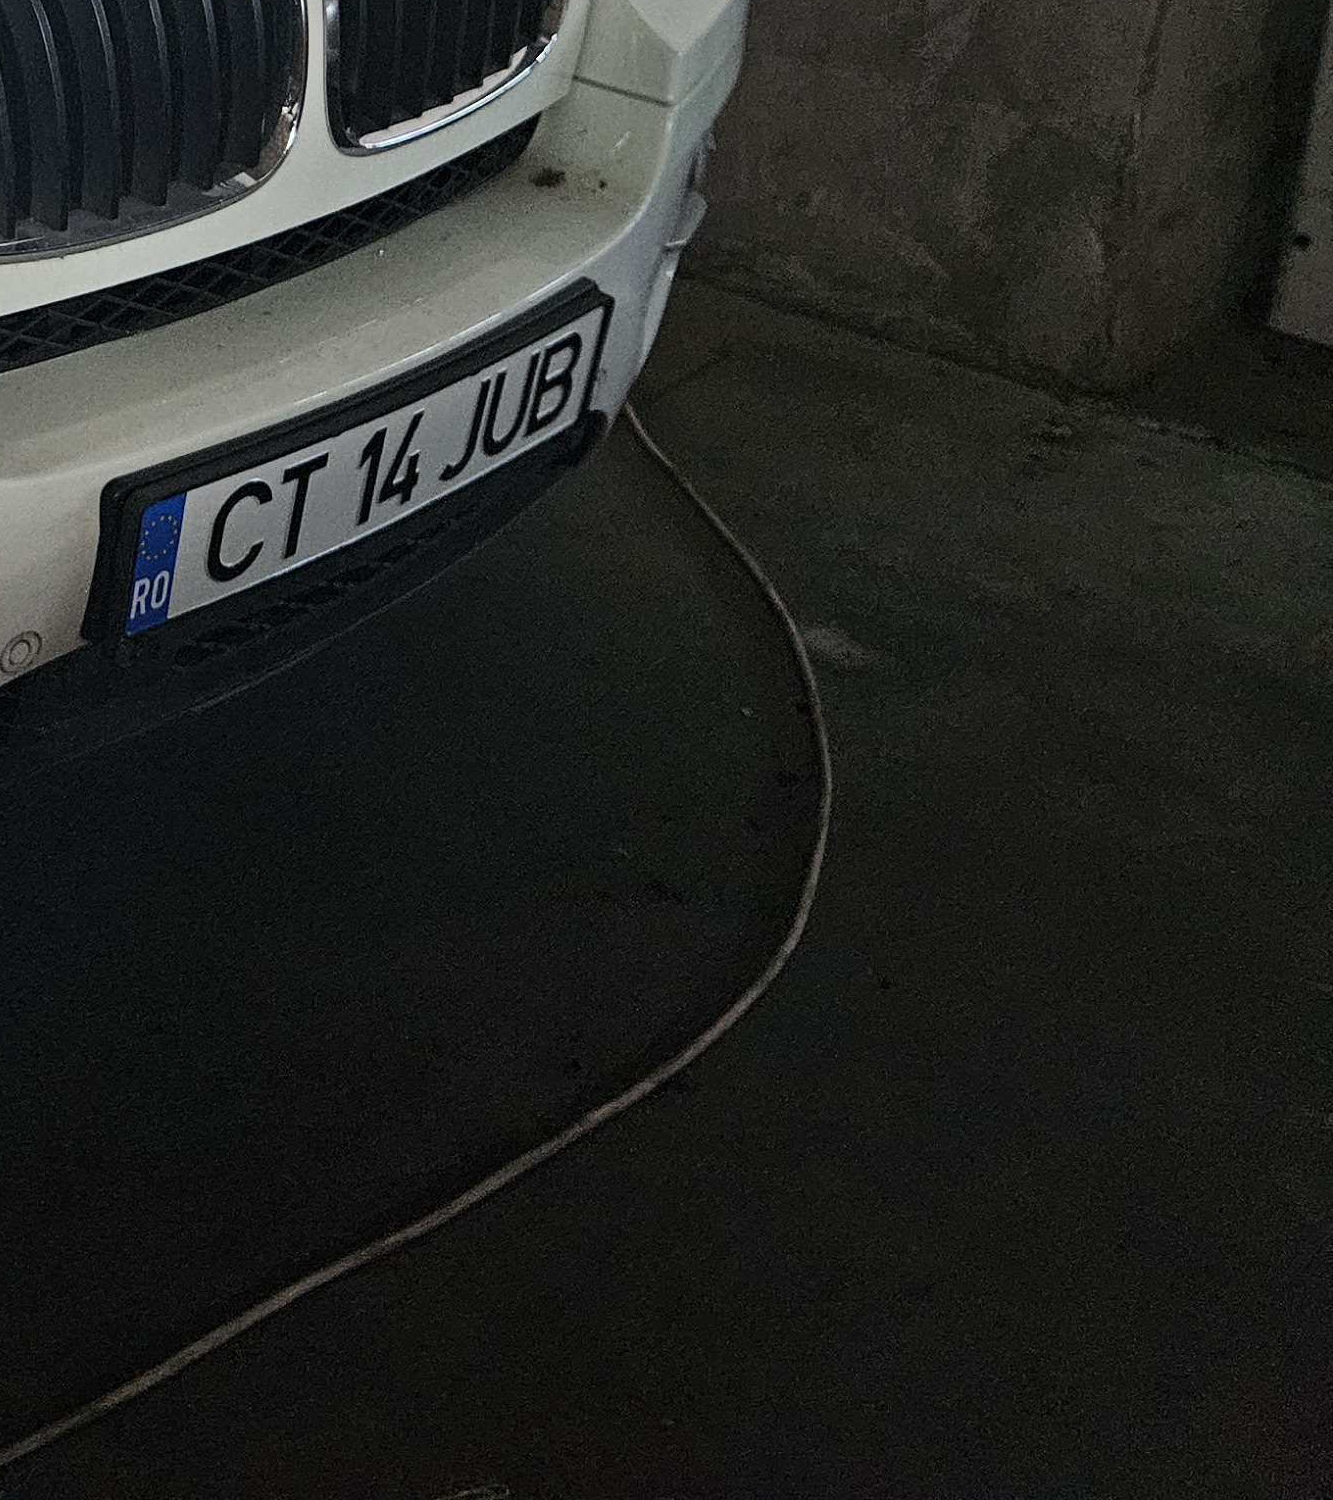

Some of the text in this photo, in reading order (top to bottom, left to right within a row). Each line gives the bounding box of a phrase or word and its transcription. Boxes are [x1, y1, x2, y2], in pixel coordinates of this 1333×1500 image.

[207, 331, 583, 583] CT 14 JUB
[130, 570, 170, 619] RO
